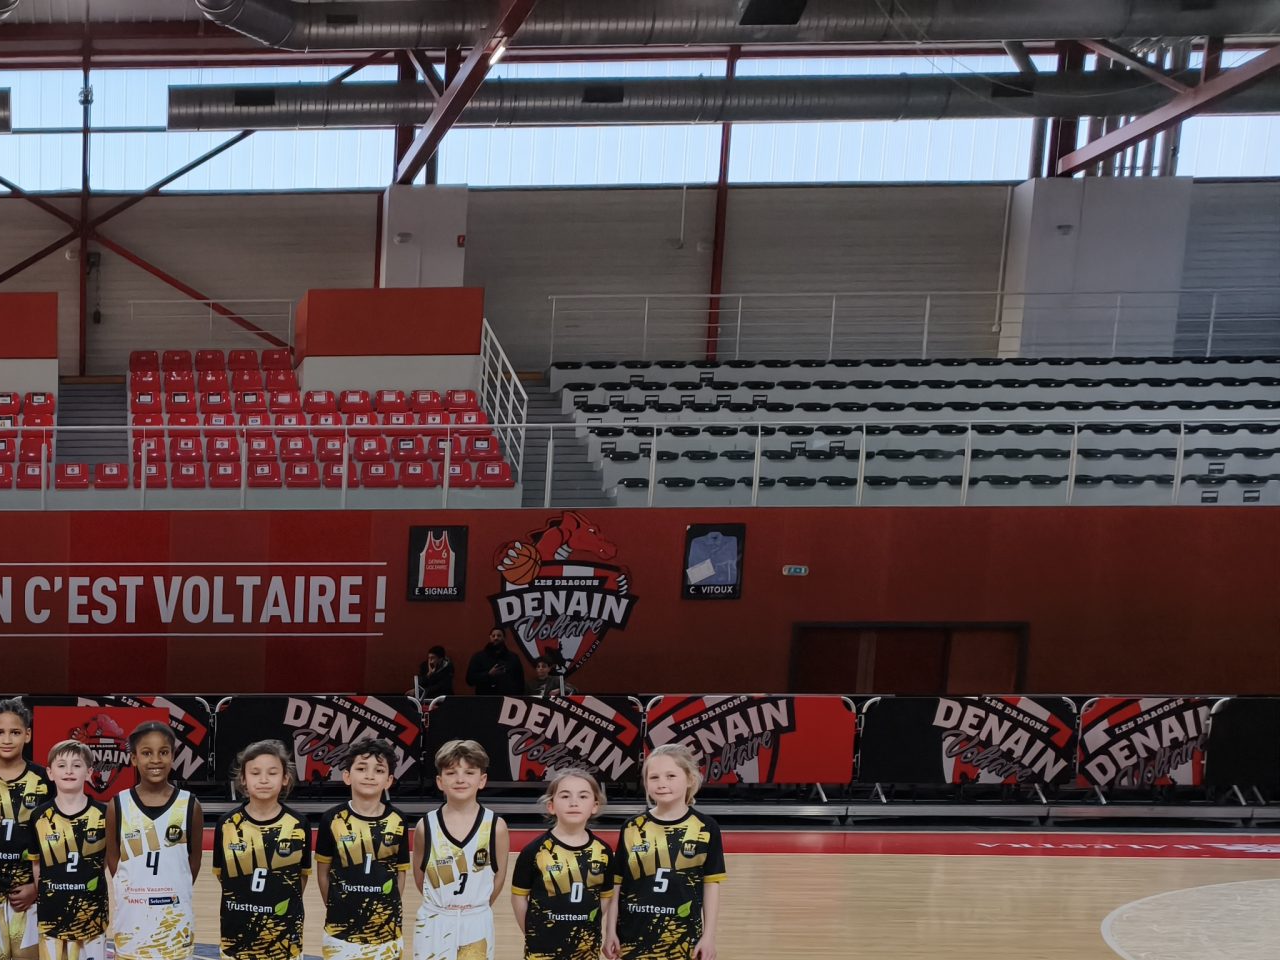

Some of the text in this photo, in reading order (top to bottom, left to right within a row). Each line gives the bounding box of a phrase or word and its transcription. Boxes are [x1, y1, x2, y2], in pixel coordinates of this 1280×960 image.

[441, 549, 447, 558] 6
[24, 576, 144, 624] C'EST
[153, 575, 362, 624] VOLTAIRE
[424, 587, 458, 595] SIGNARS
[701, 586, 734, 594] VITOUX
[496, 590, 629, 624] DENAIN
[514, 614, 604, 642] Voltaire
[332, 695, 397, 732] LES DRAGONS
[549, 695, 615, 732] LES DRAGONS
[680, 695, 748, 731] LES DRAGONS
[984, 697, 1050, 734] LES DRAGONS
[1115, 698, 1185, 735] LES DRAGONS
[283, 697, 417, 781] DENAN
[497, 696, 634, 782] DENAIN
[677, 699, 790, 761] ENAIN
[932, 697, 1069, 783] DENAIN
[93, 749, 131, 765] NAIN
[942, 729, 1033, 783] Voltaire
[1, 818, 14, 841] 7
[66, 851, 79, 873] 2
[146, 851, 160, 876] 4
[364, 853, 373, 875] 1
[47, 881, 86, 891] Trustteam
[251, 867, 267, 893] 6
[341, 882, 382, 894] Trustteam
[571, 881, 583, 903] 0
[653, 867, 671, 893] 5
[226, 900, 273, 914] Trustteam
[548, 912, 588, 922] Trustteam
[627, 903, 676, 915] Trustteam
